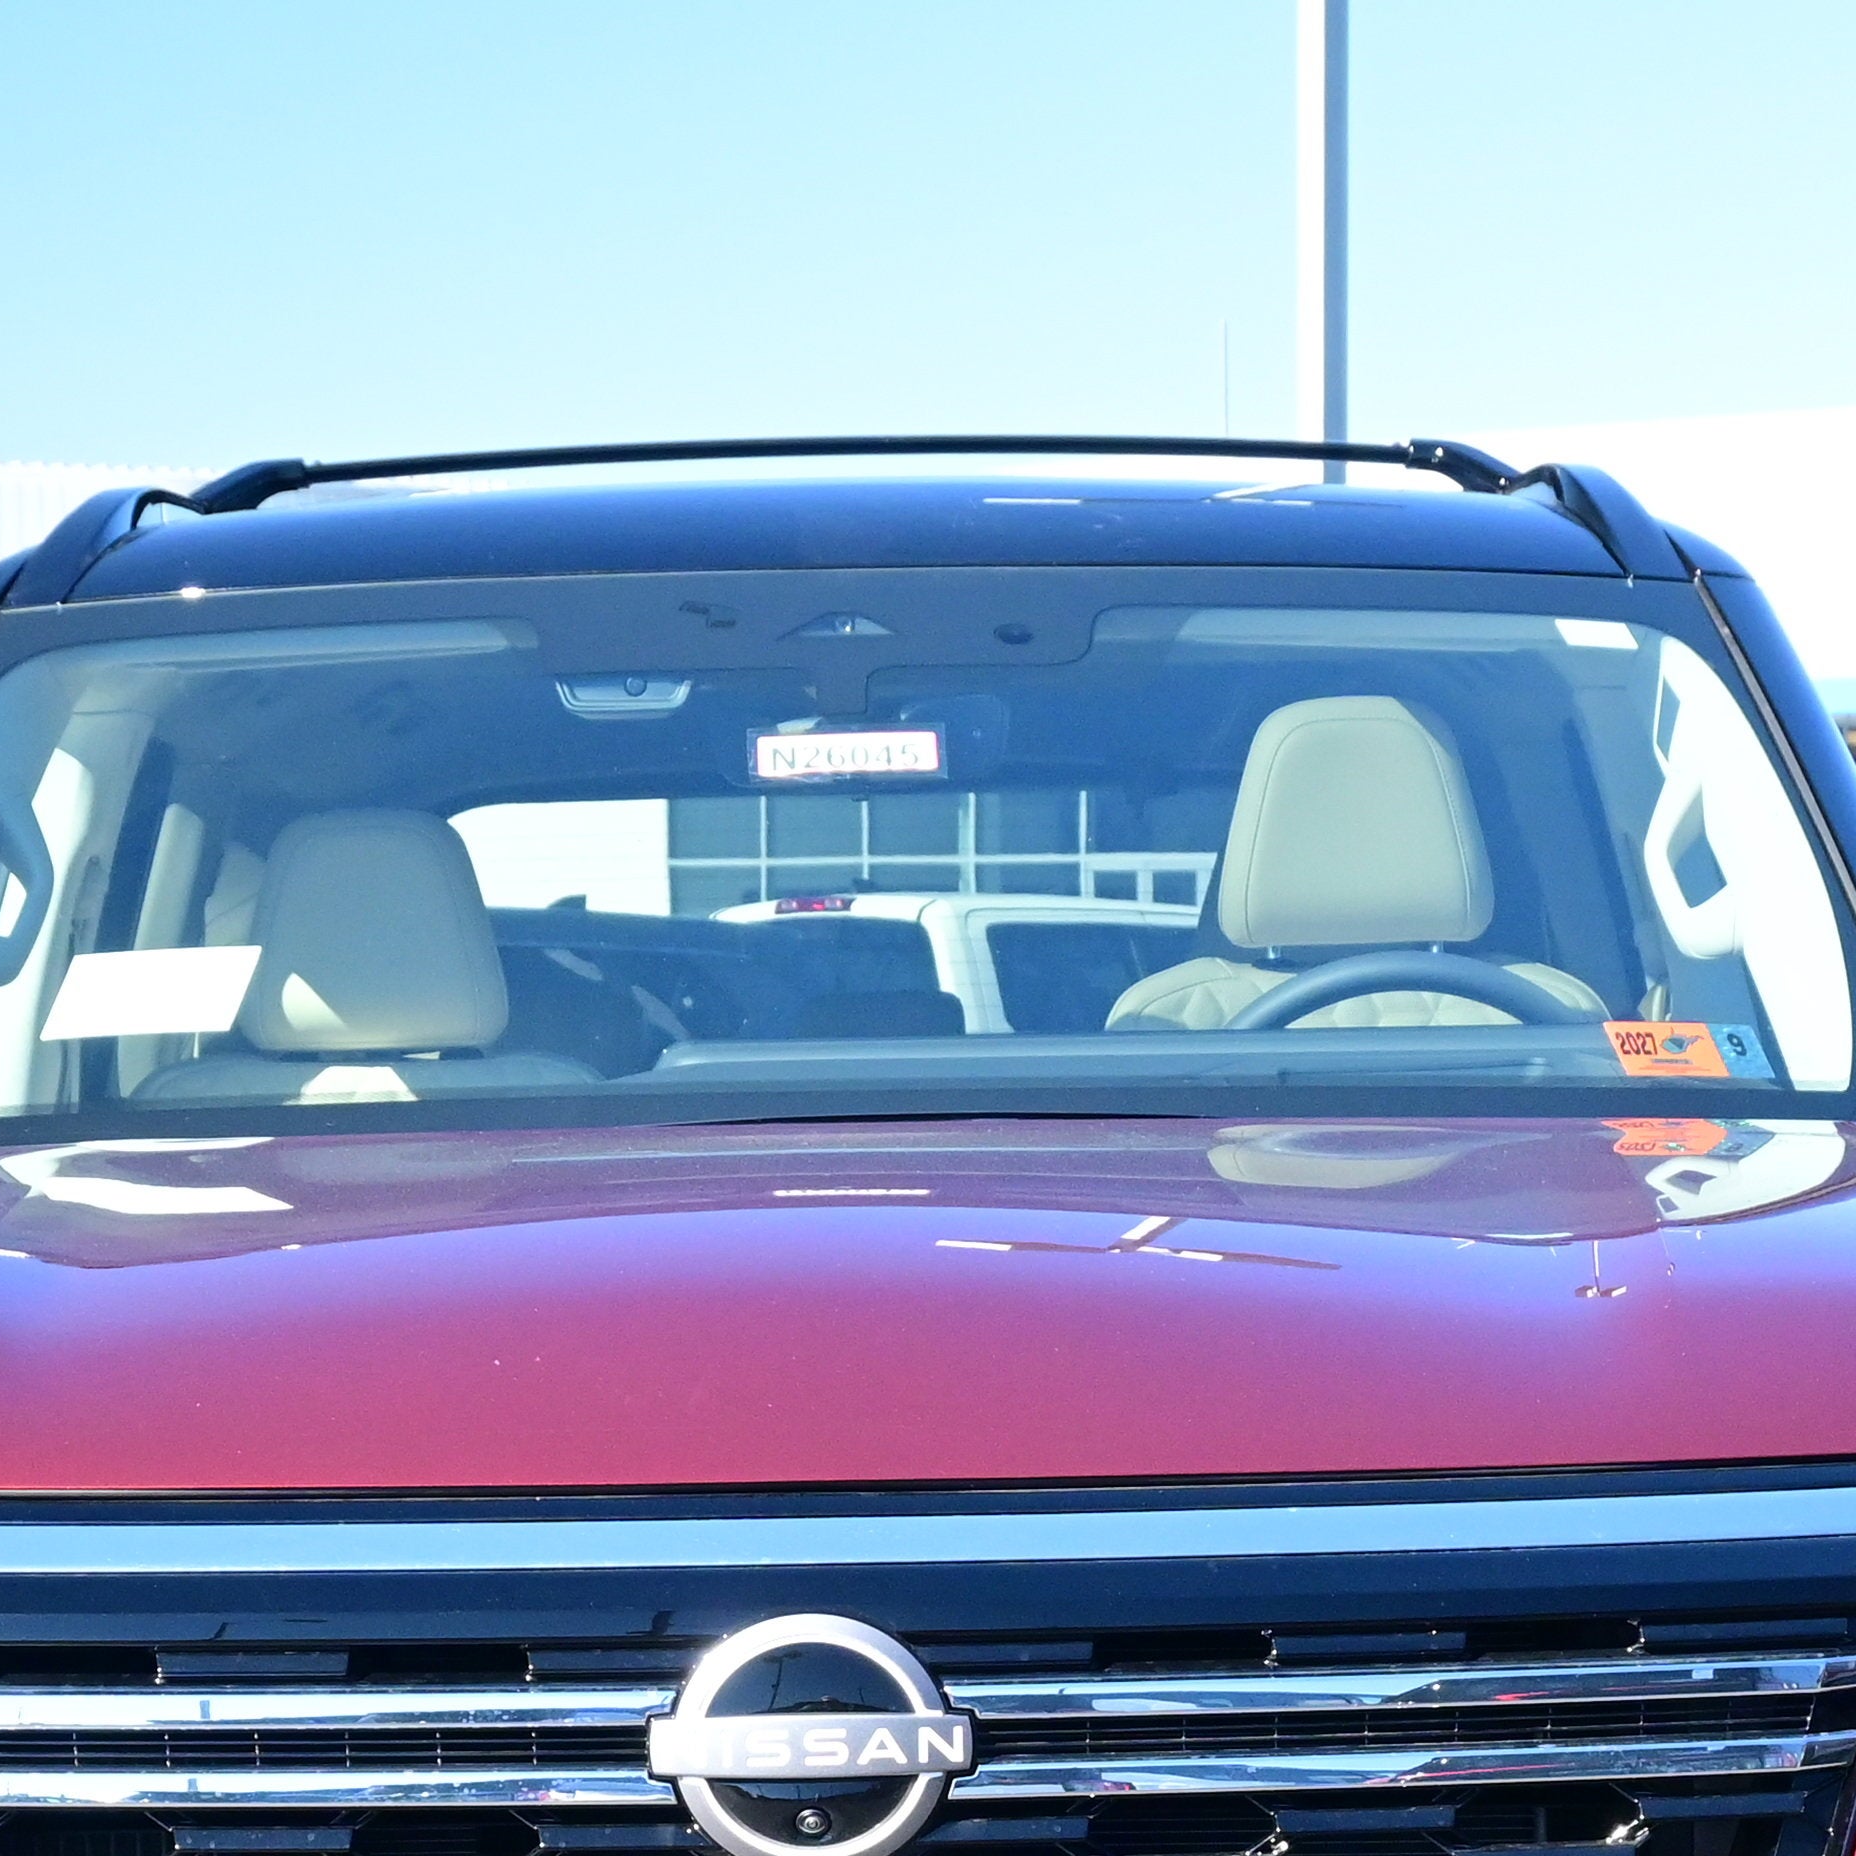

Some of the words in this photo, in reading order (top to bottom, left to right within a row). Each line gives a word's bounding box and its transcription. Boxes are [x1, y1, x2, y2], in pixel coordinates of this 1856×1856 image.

[771, 743, 919, 771] N26045
[1616, 1031, 1658, 1056] 2027
[1727, 1033, 1748, 1056] 9
